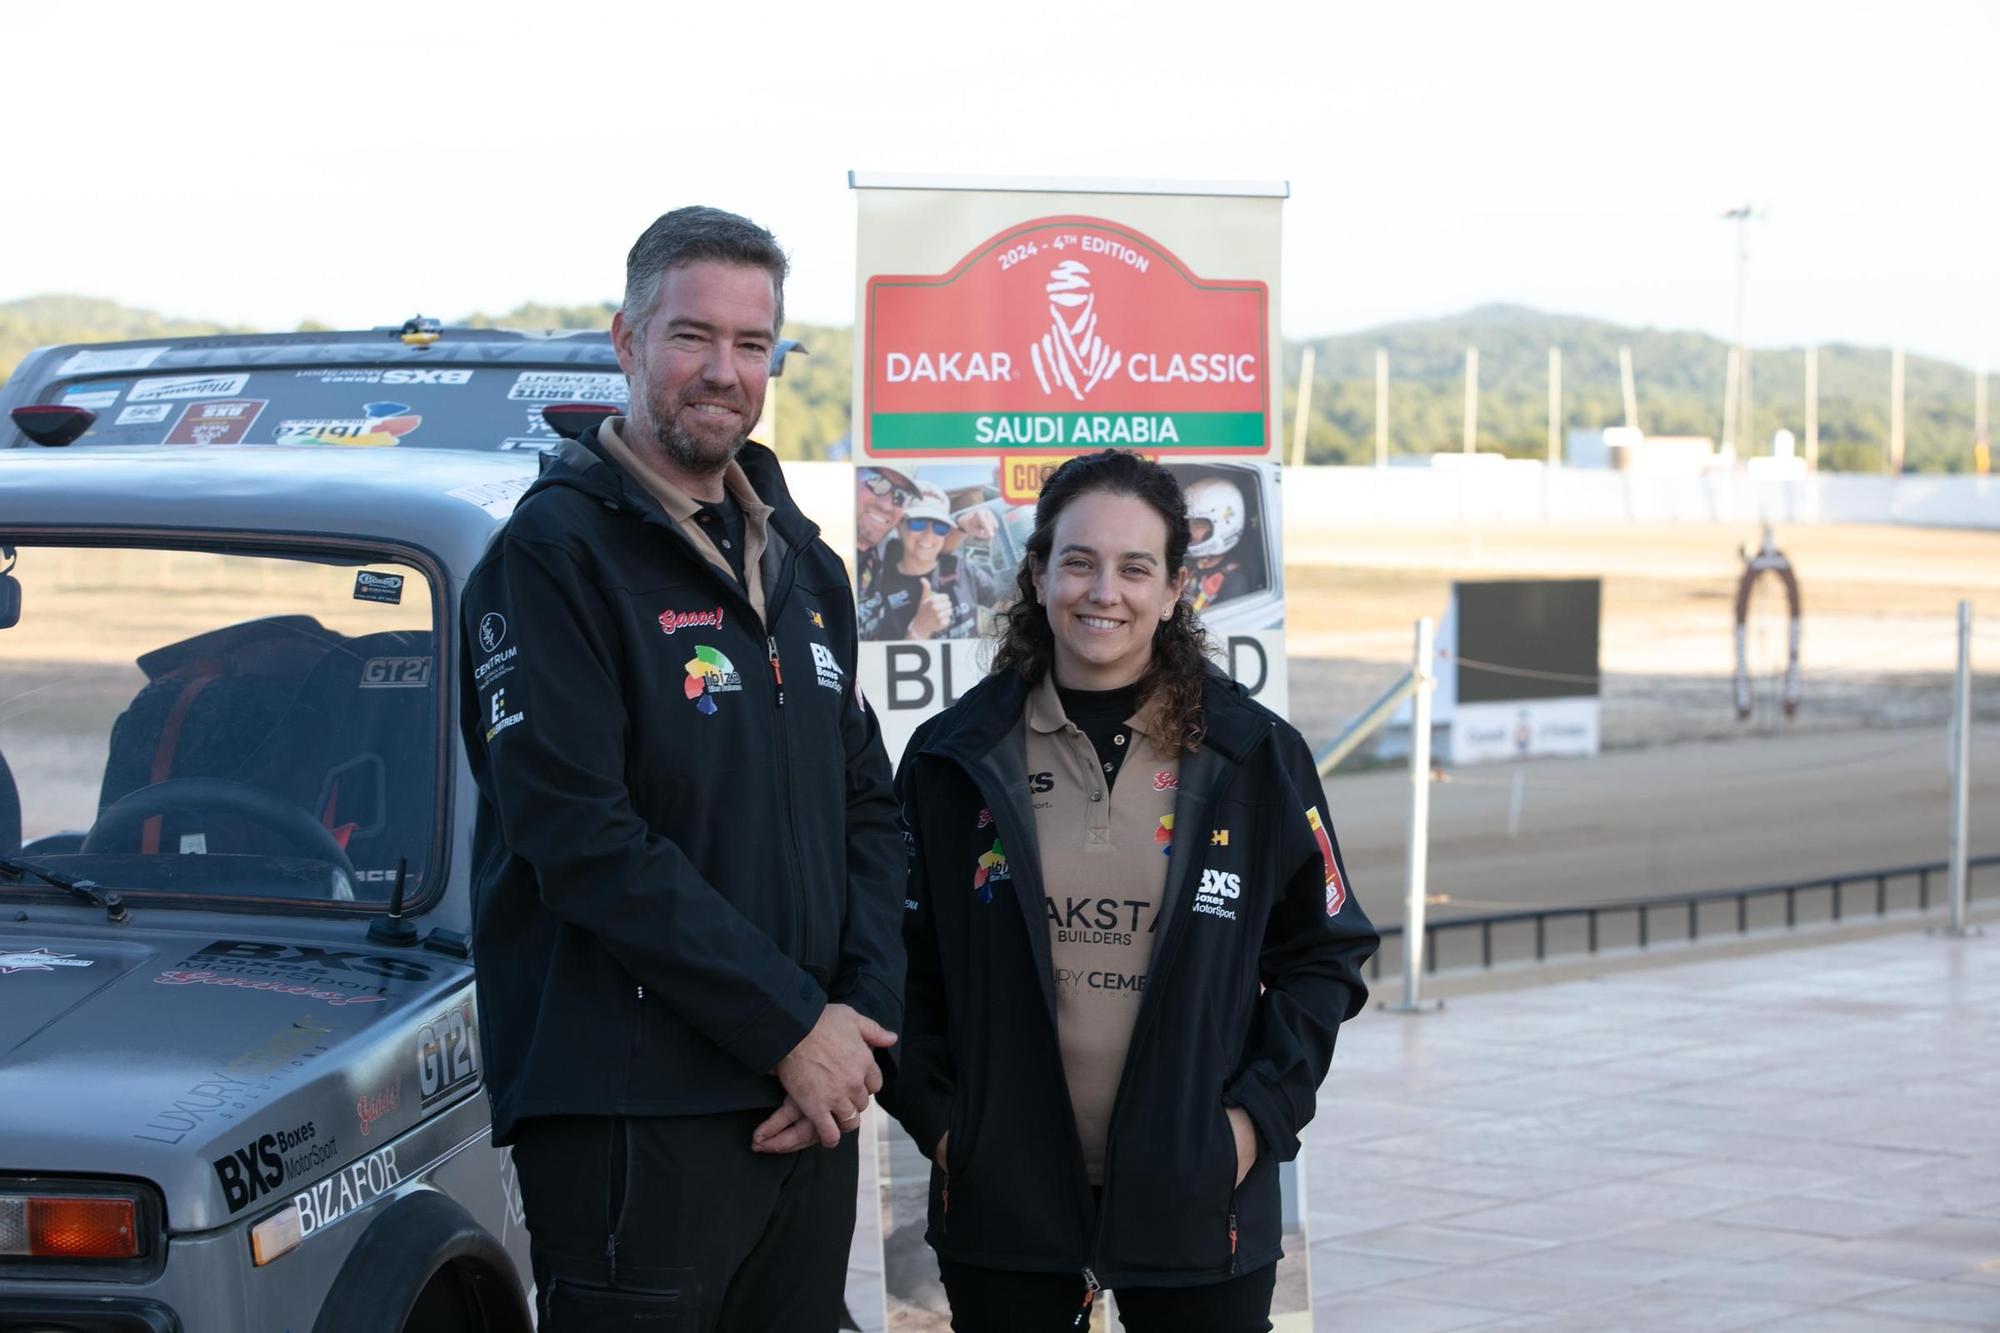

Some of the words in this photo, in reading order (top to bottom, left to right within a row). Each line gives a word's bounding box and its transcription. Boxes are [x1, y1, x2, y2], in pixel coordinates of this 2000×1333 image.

[998, 242, 1038, 271] 2024
[1082, 236, 1150, 274] EDITION
[381, 369, 475, 385] BXS
[886, 353, 1012, 382] DAKAR
[1127, 353, 1257, 383] CLASSIC
[273, 425, 363, 438] Ibiza
[975, 416, 1064, 444] SAUDI
[1071, 416, 1180, 443] ARABIA
[474, 645, 518, 680] CENTRUM
[1057, 930, 1133, 946] BUILDERS
[186, 954, 331, 976] Boxes
[196, 940, 435, 982] BXS
[133, 1072, 252, 1145] LUXURY
[277, 1121, 316, 1154] Boxes
[213, 1133, 284, 1215] BXS
[285, 1136, 338, 1183] MotorSport
[295, 1146, 400, 1238] BIZAFOR
